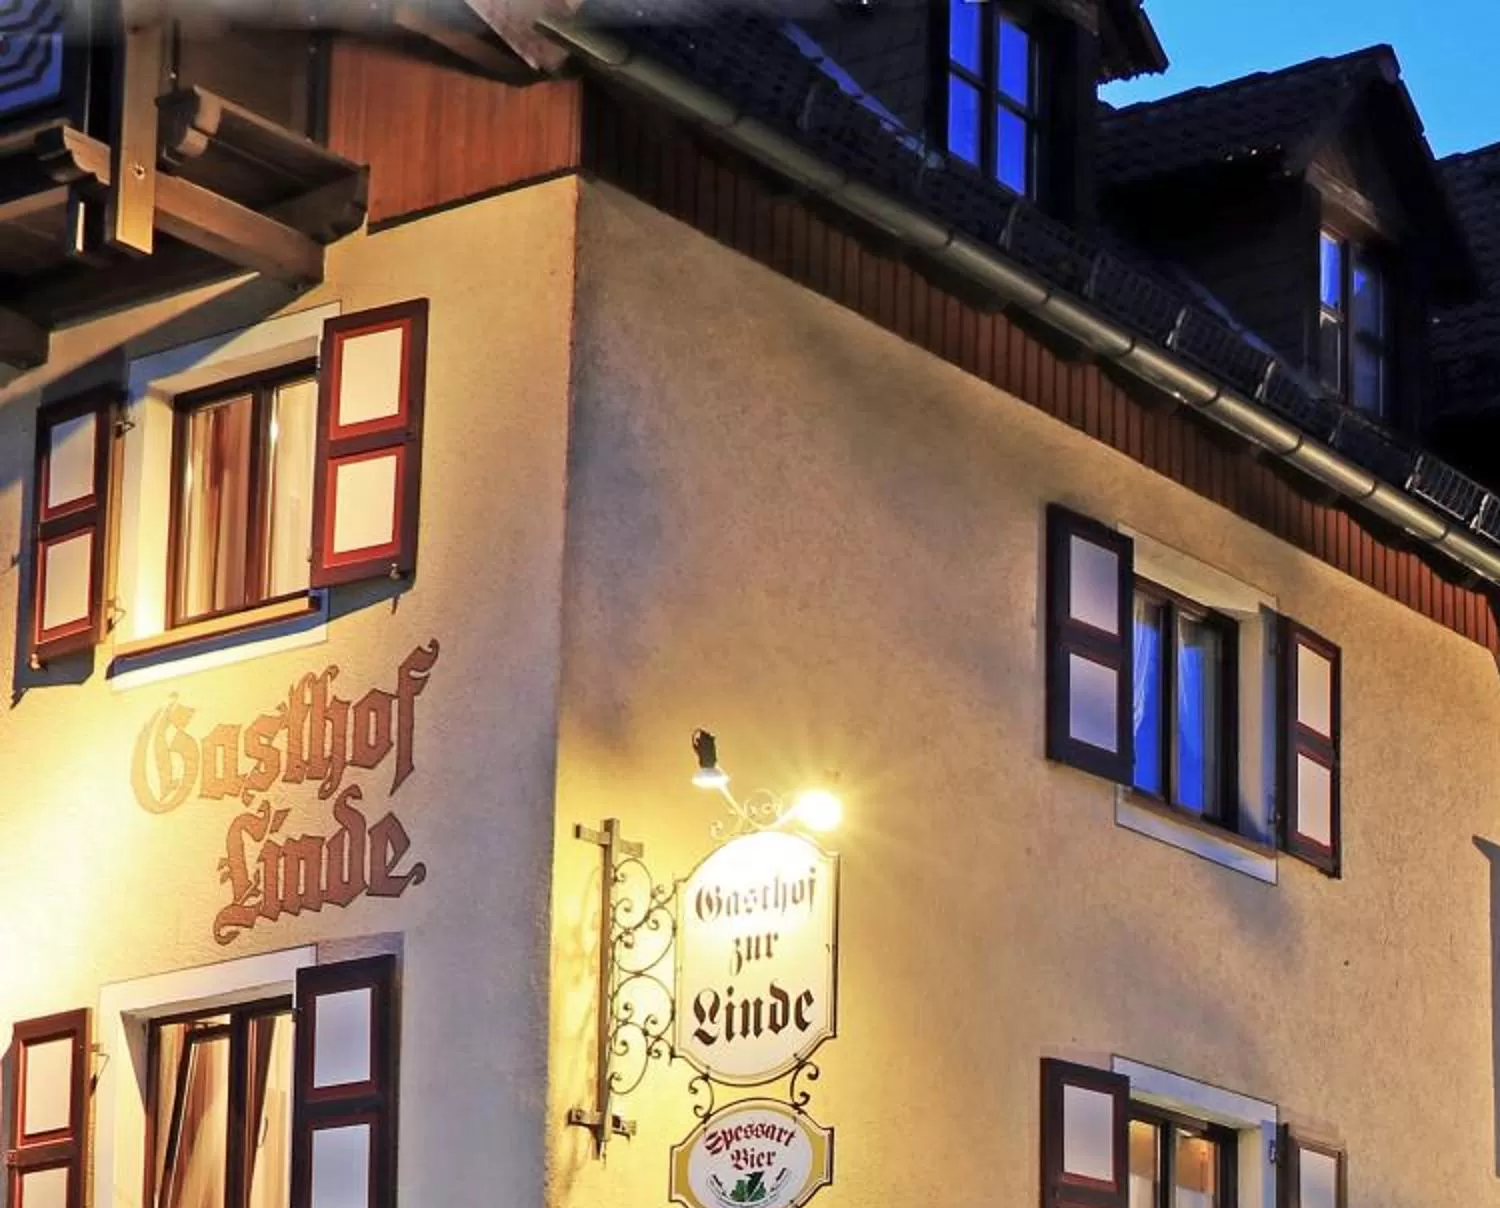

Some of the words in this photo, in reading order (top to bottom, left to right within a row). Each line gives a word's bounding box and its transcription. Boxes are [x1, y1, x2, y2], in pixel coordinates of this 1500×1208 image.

[131, 638, 440, 814] Gasthof
[213, 784, 427, 945] Linde
[695, 866, 816, 921] Gasthof
[730, 932, 779, 976] zur
[692, 978, 815, 1046] Linde
[704, 1121, 797, 1156] Spessart
[731, 1147, 777, 1170] Bier
